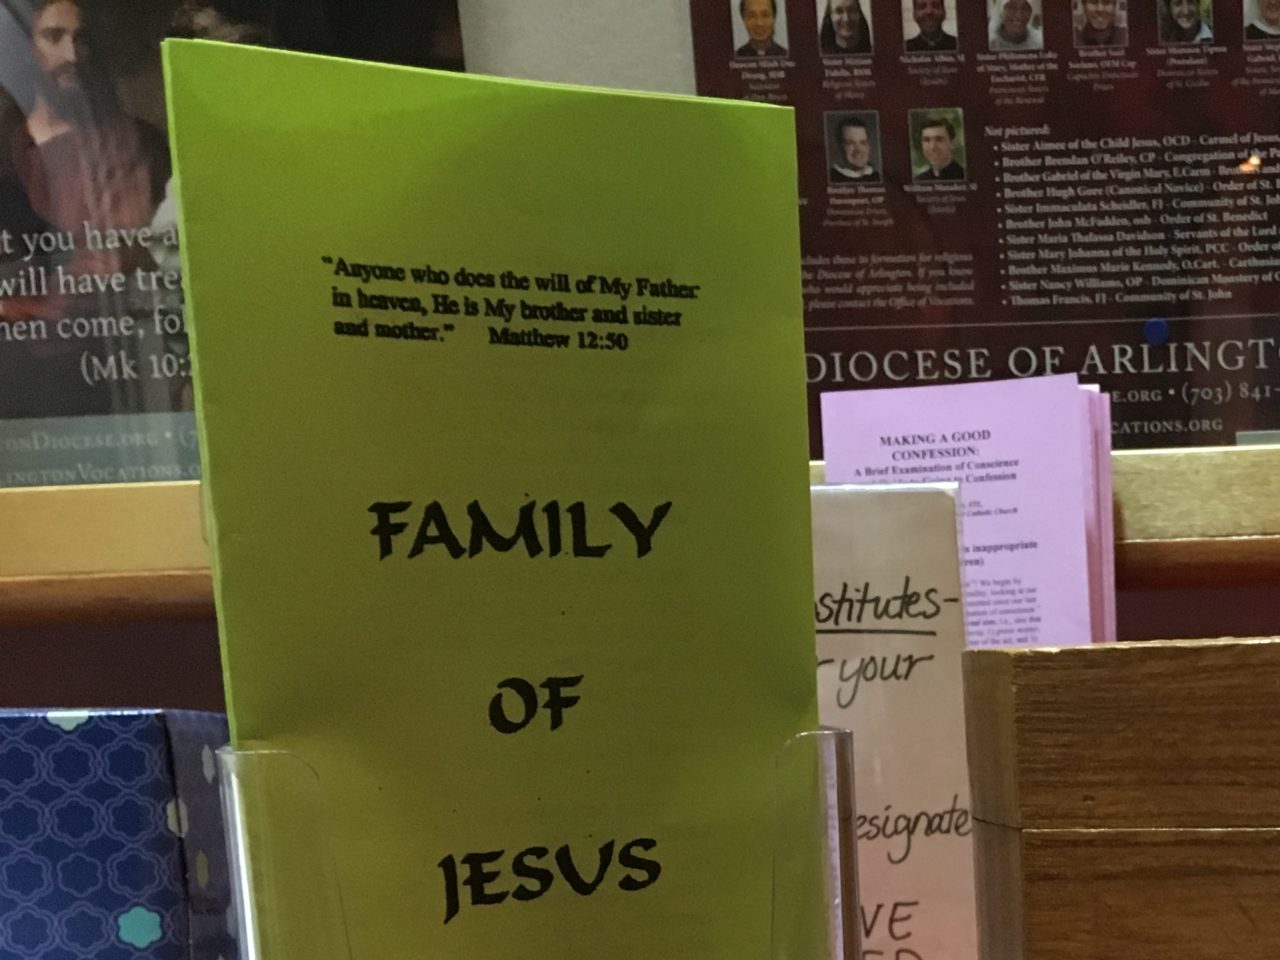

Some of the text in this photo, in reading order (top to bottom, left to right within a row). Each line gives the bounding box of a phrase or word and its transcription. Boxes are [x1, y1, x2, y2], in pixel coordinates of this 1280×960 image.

[1001, 141, 1031, 152] Sister
[1068, 138, 1079, 149] of
[1081, 138, 1098, 149] the
[1100, 137, 1131, 149] Child
[1239, 132, 1251, 144] of
[1246, 179, 1258, 190] of
[22, 231, 75, 262] you
[83, 220, 151, 253] have
[57, 265, 125, 295] have
[136, 266, 183, 292] tre
[410, 265, 450, 286] who
[454, 267, 496, 288] does
[500, 270, 530, 290] the
[535, 273, 571, 293] will
[575, 275, 597, 294] of
[599, 276, 632, 300] My
[636, 277, 701, 299] Father
[332, 286, 682, 326] in heaven, He is My brother and sister
[57, 314, 145, 341] come,
[334, 318, 369, 337] and
[488, 327, 570, 348] Matthew
[578, 331, 629, 351] 12:50
[81, 350, 192, 386] (Mk 10:
[807, 349, 992, 383] DIOCESE
[1008, 346, 1065, 377] OF
[1181, 381, 1233, 405] (703)
[880, 430, 991, 447] MAKING A GOOD
[854, 459, 1019, 477] A Brief Examination of Conscience
[966, 471, 1017, 483] Confession
[367, 499, 673, 560] FAMILY
[972, 541, 1038, 554] inappropriate
[837, 653, 935, 709] your
[489, 674, 584, 734] OF
[856, 793, 972, 864] esignate
[437, 838, 661, 924] JESUS
